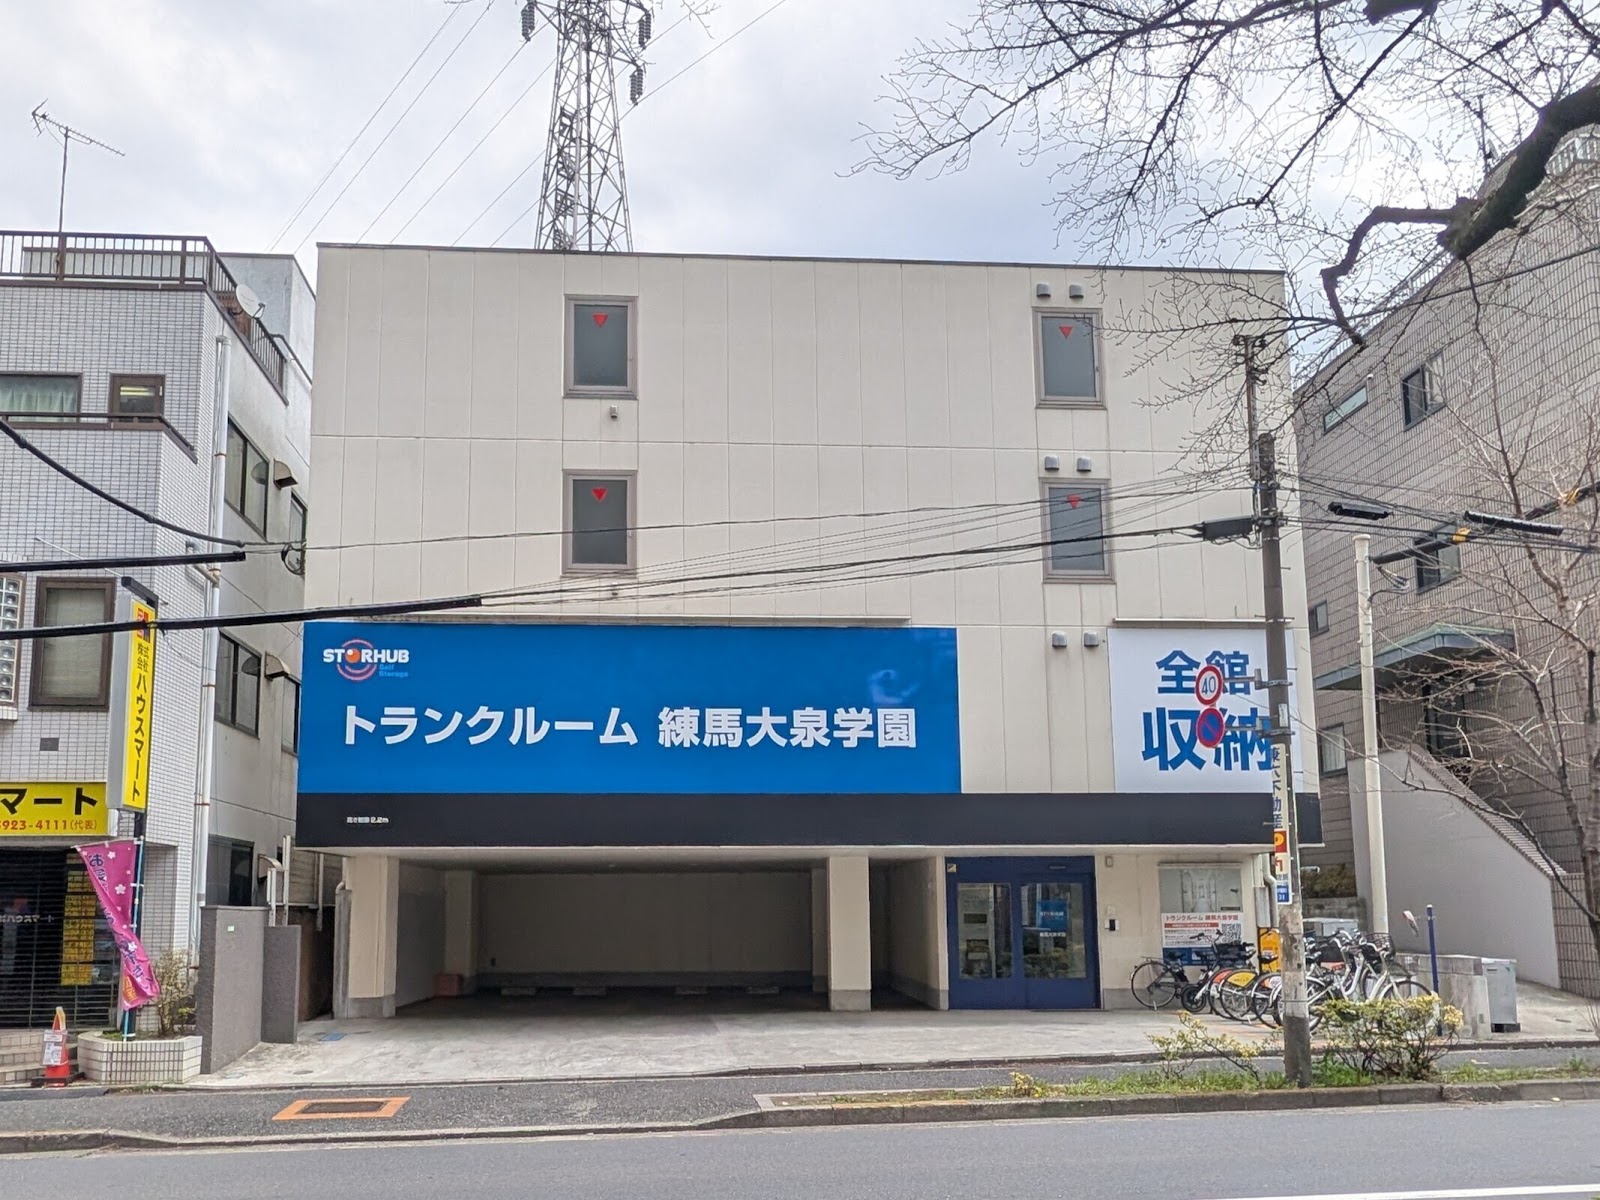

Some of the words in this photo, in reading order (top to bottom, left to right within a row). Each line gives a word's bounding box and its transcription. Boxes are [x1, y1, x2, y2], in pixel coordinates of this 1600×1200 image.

[1156, 650, 1251, 695] 全館
[1201, 676, 1216, 694] 40
[345, 705, 638, 745] トランクルーム
[658, 707, 917, 748] 練馬大泉学園
[0, 787, 98, 815] マート
[0, 820, 97, 830] 923-4111(代表)
